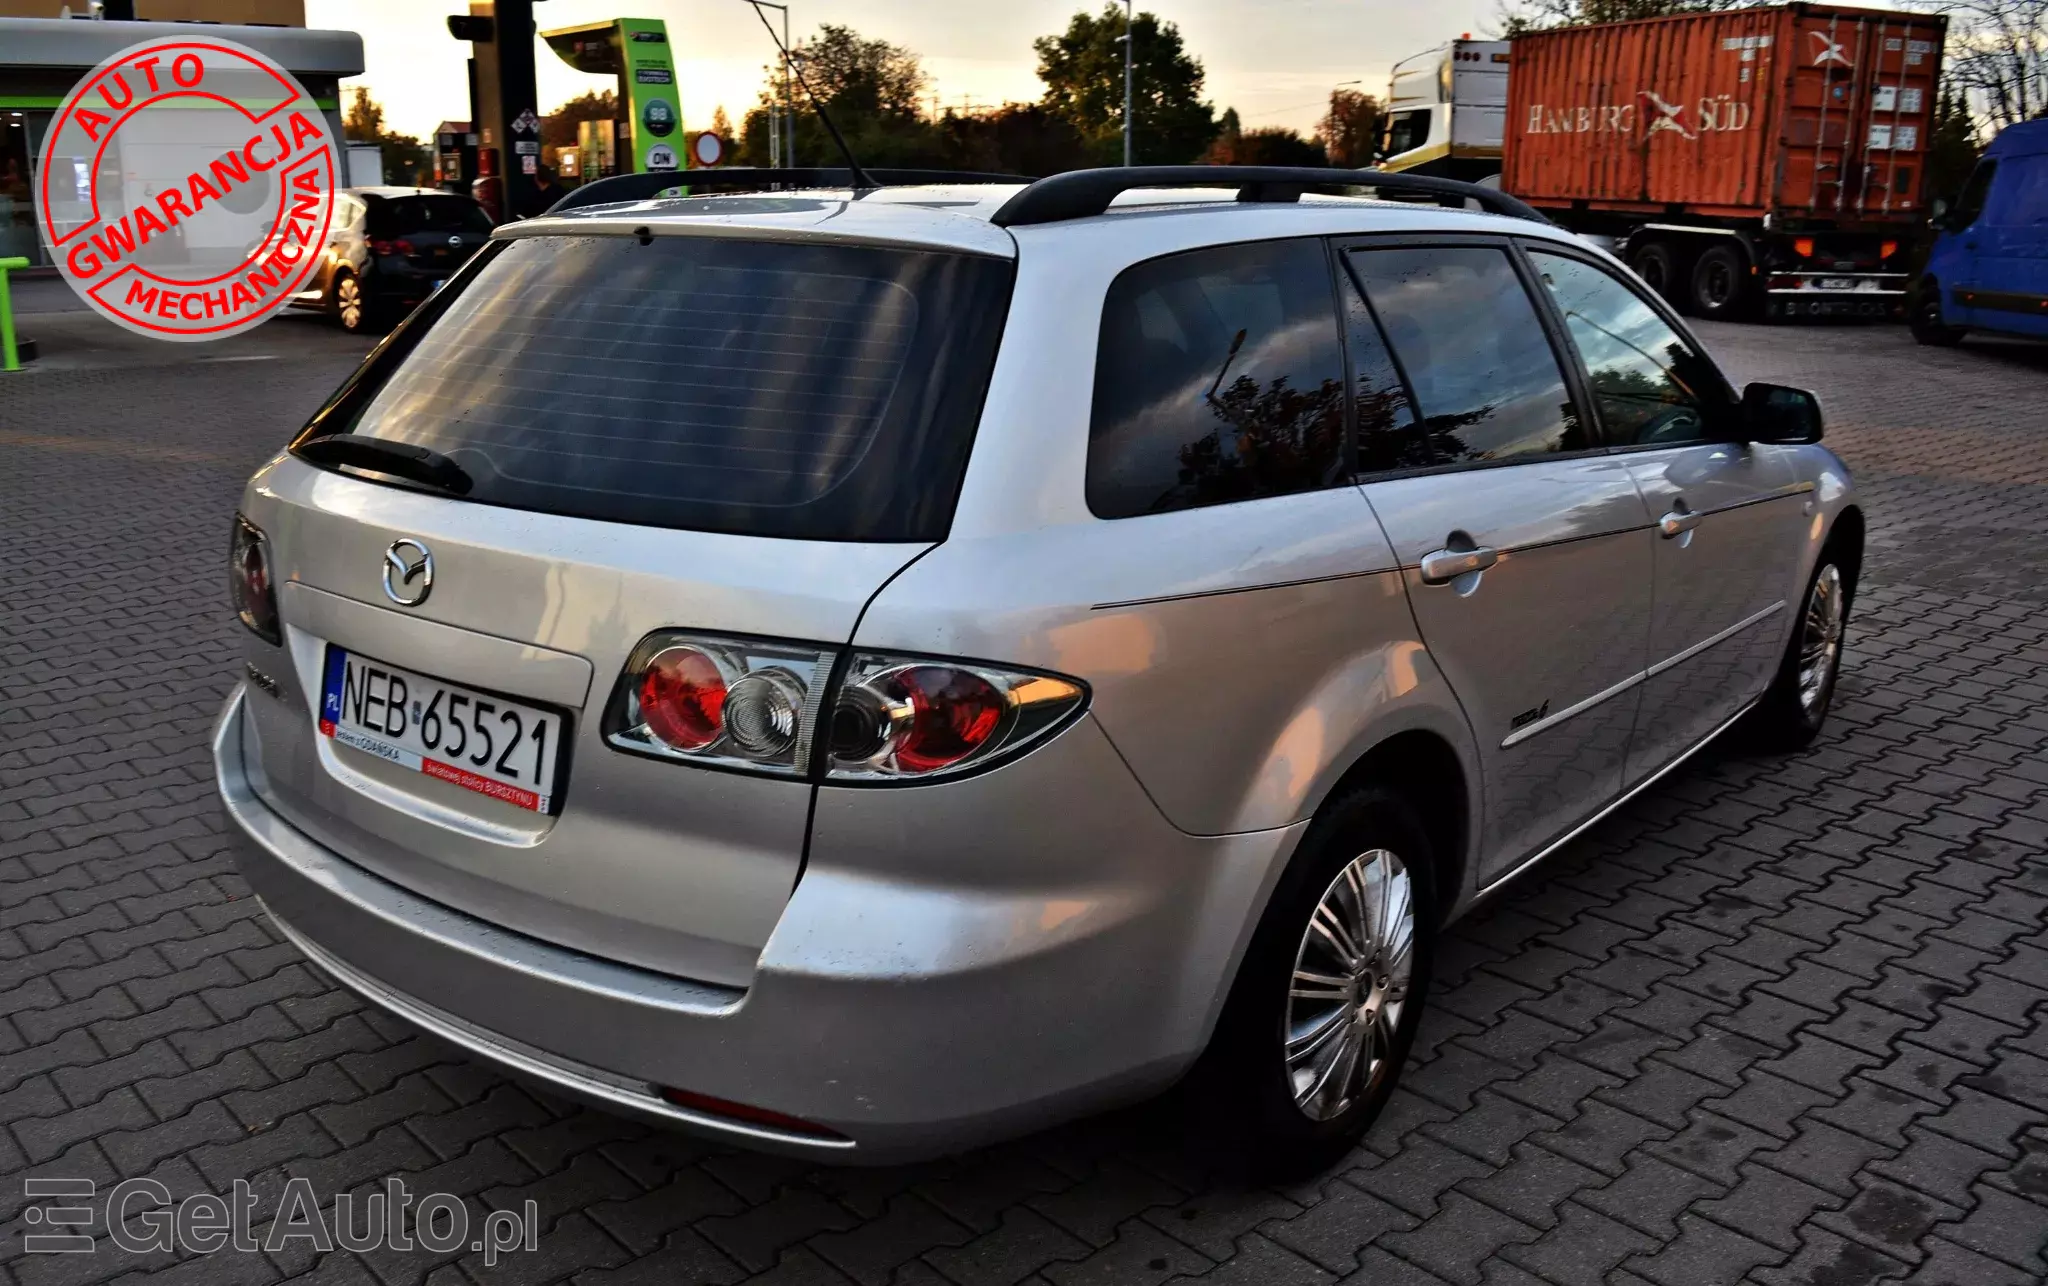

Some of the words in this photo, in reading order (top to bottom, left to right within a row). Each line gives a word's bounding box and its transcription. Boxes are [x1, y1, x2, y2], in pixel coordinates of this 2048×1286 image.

[1696, 94, 1750, 132] SÜD
[653, 152, 672, 165] ON
[341, 660, 409, 738] NEB
[420, 689, 548, 786] 65521
